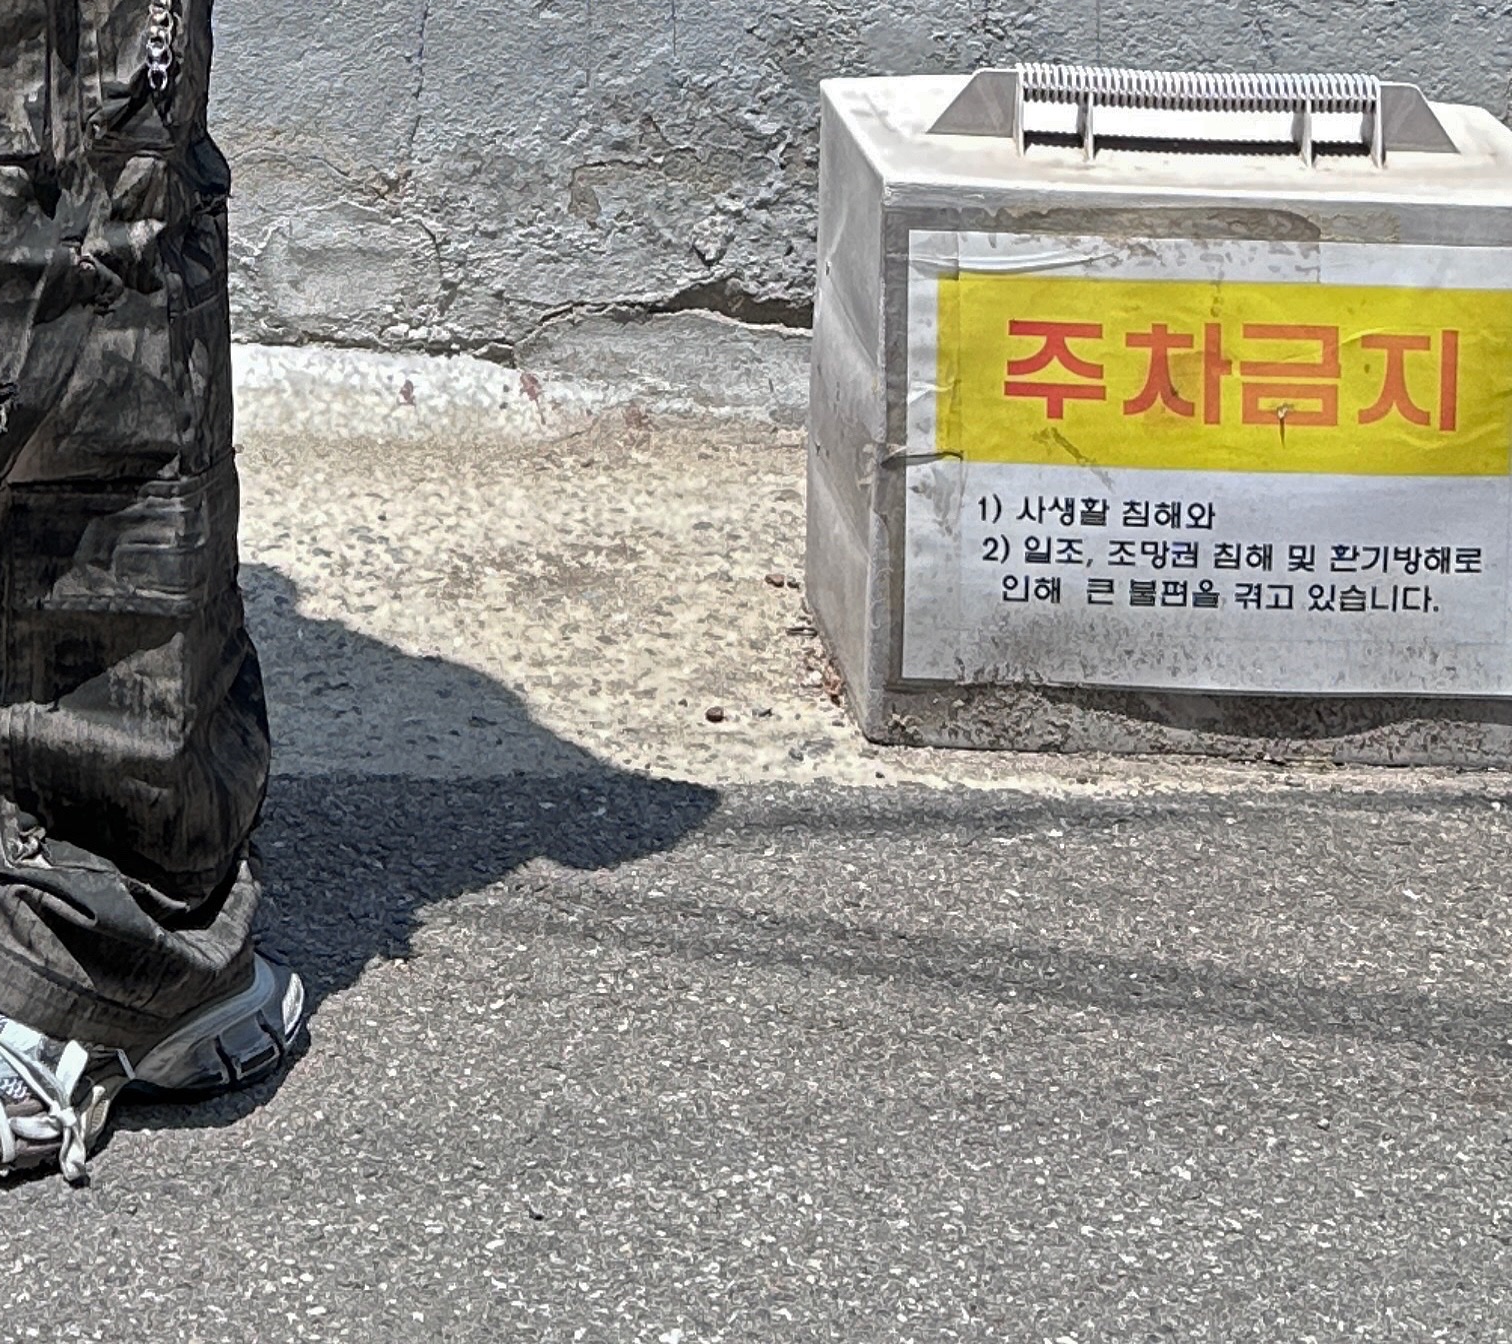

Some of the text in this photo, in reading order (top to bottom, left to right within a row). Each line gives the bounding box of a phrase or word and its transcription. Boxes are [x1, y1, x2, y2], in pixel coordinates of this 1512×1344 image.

[1003, 319, 1460, 433] 주차금지
[977, 493, 1217, 530] 1) 사생활 침해와
[981, 534, 1483, 575] 2) 일조, 조망권 침해 및 환기방해로
[1002, 574, 1440, 613] 인해 큰 불편을 겪고 있습니다.
